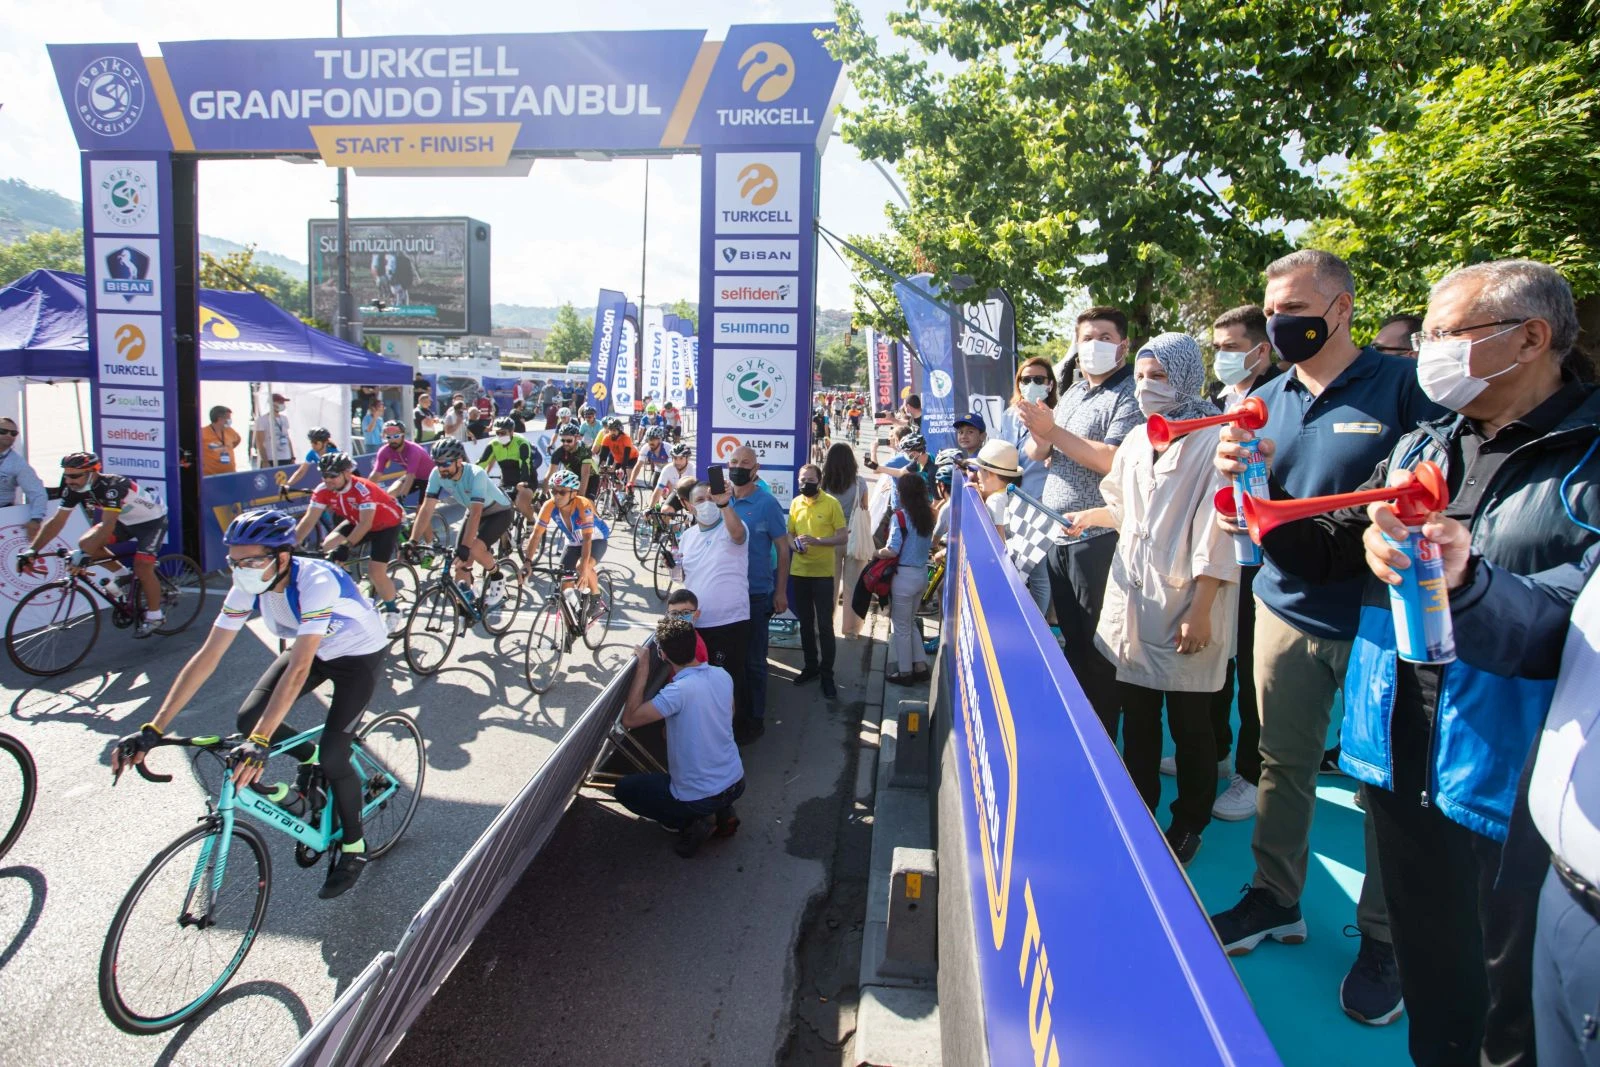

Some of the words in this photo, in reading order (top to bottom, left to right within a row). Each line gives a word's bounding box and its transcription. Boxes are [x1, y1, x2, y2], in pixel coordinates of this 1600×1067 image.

[314, 46, 519, 80] TURKCELL
[79, 59, 140, 88] Beykoz
[189, 86, 442, 120] GRANFONDO
[451, 79, 662, 117] İSTANBUL
[716, 108, 815, 126] TURKCELL
[335, 136, 405, 154] START
[420, 135, 494, 153] FINISH
[102, 168, 148, 190] Beykoz
[722, 210, 793, 223] TURKCELL
[405, 234, 435, 253] ünü
[721, 287, 780, 301] selfiden
[720, 322, 790, 335] SHIMANO
[103, 363, 159, 377] TURKCELL
[726, 359, 784, 383] Beykoz
[118, 396, 160, 408] soultech
[726, 396, 783, 420] Belediyesi
[107, 428, 151, 441] selfiden
[745, 440, 772, 449] ALEM
[774, 440, 789, 449] FM
[107, 457, 160, 469] SHIMANO
